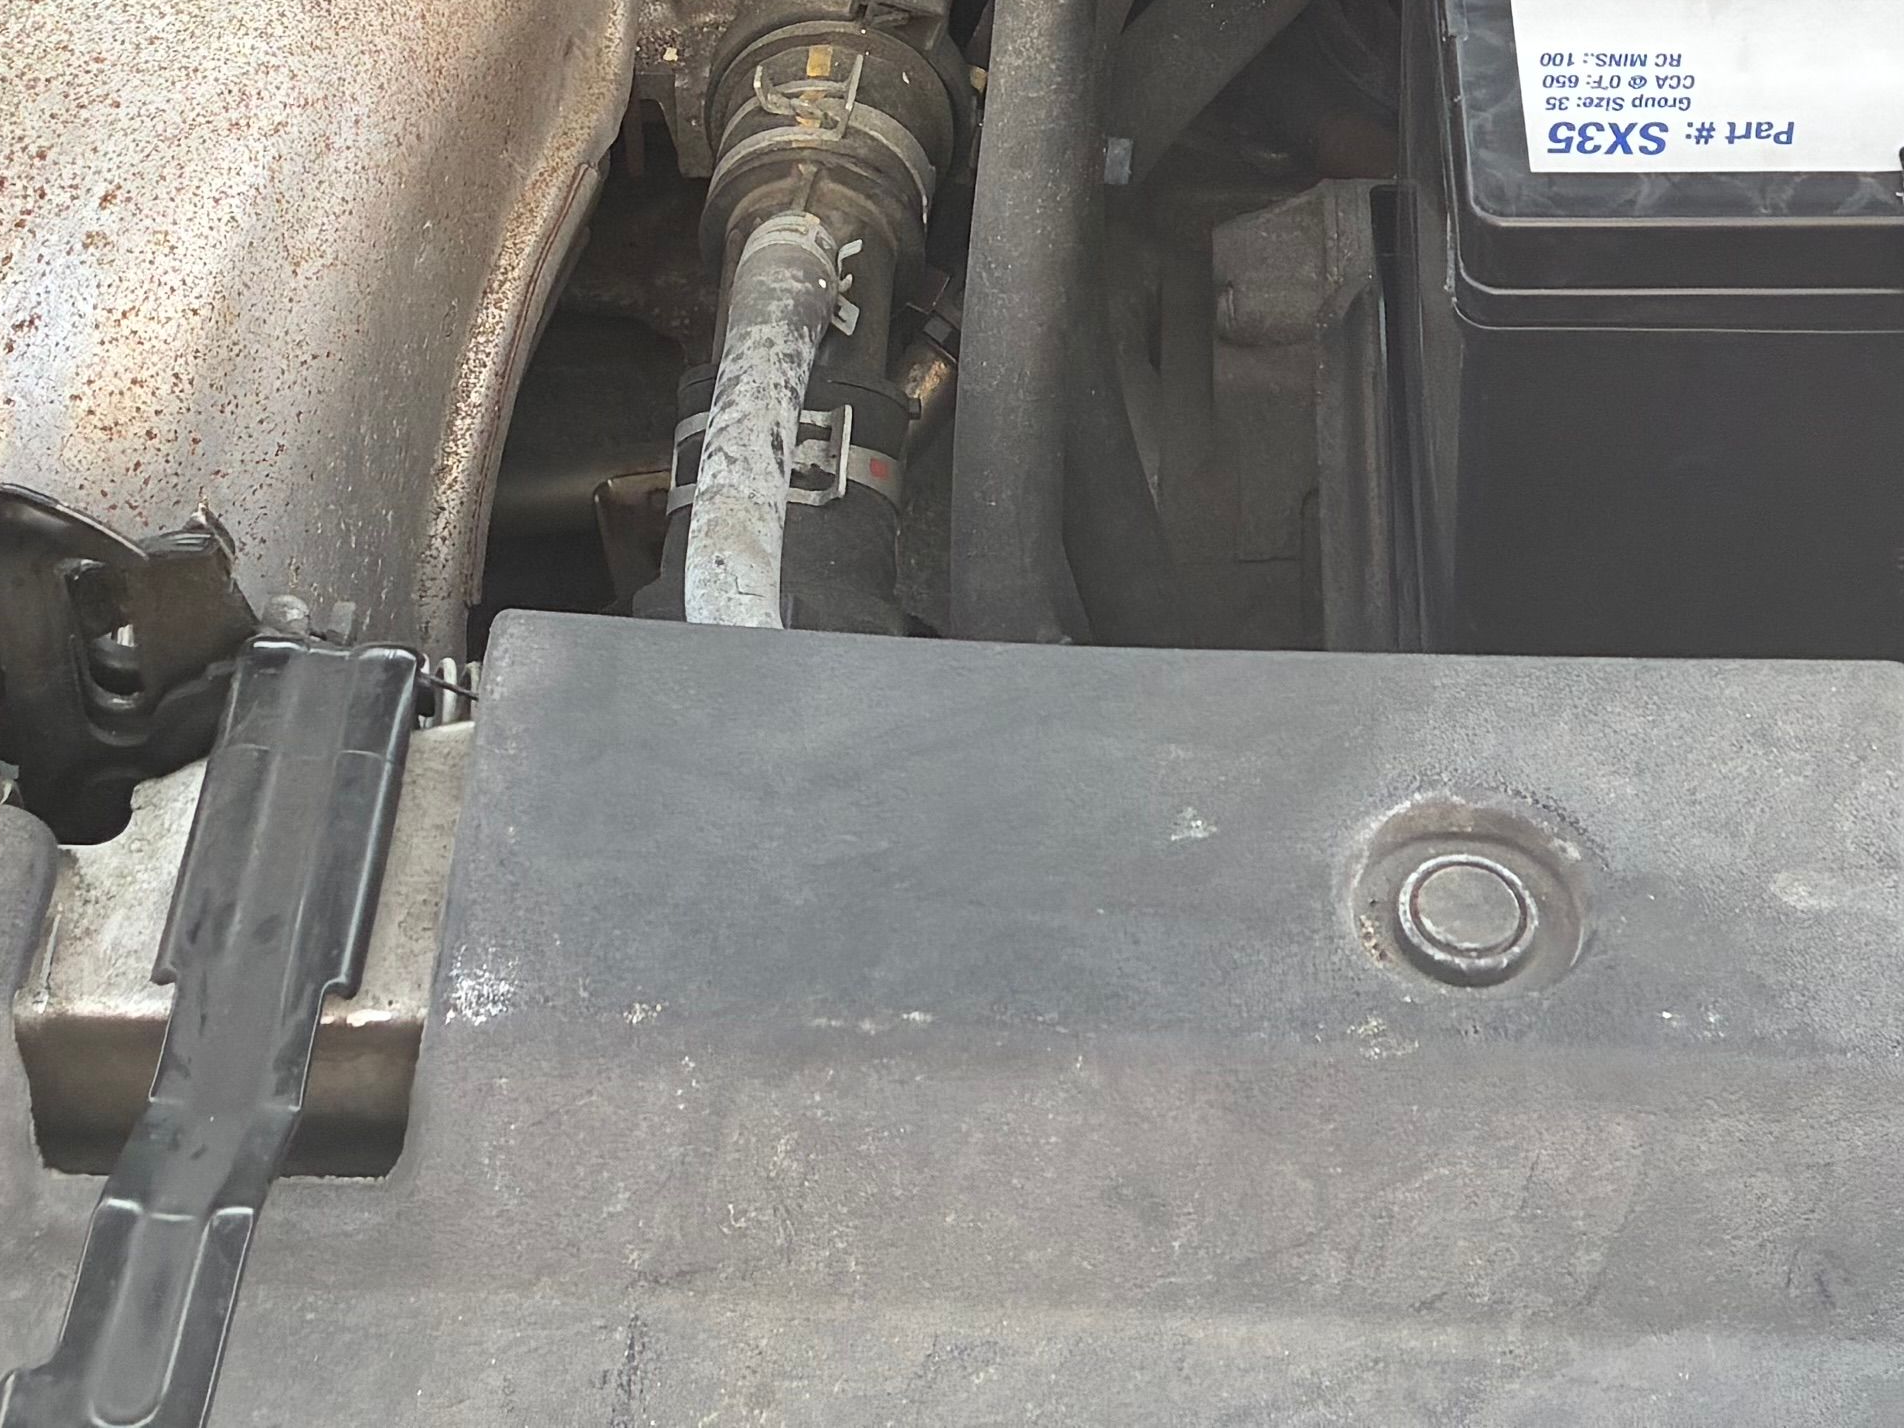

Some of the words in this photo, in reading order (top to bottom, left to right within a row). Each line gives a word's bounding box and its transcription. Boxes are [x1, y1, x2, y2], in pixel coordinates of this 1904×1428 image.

[1539, 52, 1574, 66] 100
[1655, 52, 1681, 66] RC
[1542, 74, 1578, 88] 650
[1628, 74, 1647, 88] @
[1655, 74, 1694, 88] CCA
[1545, 96, 1569, 110] 35
[1577, 96, 1624, 110] Size:
[1631, 94, 1691, 111] Group
[1546, 121, 1668, 154] SX35
[1685, 121, 1714, 144] #:
[1725, 121, 1794, 144] Part
